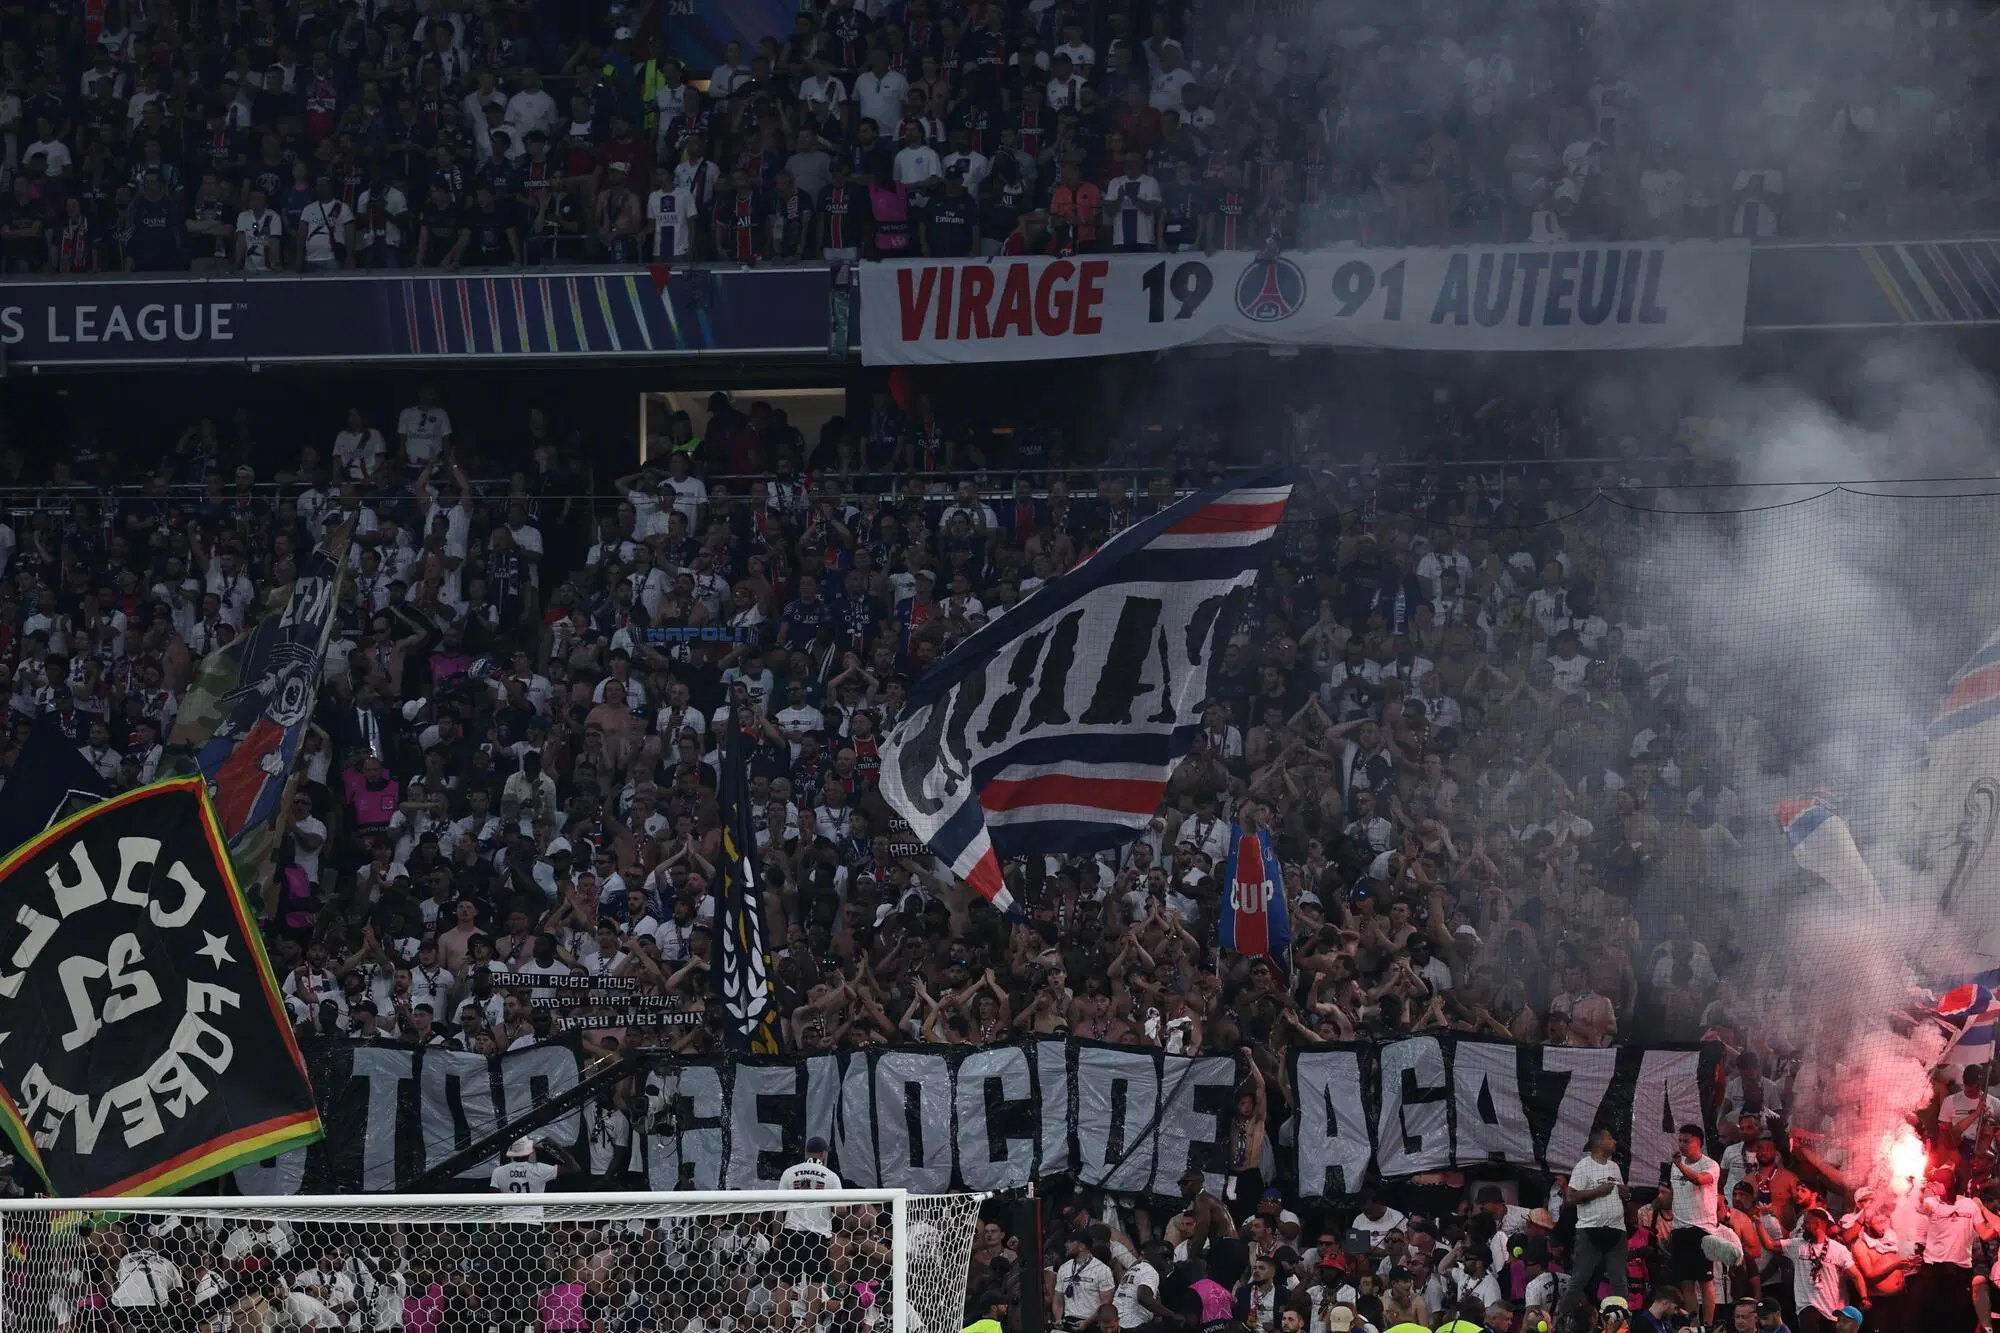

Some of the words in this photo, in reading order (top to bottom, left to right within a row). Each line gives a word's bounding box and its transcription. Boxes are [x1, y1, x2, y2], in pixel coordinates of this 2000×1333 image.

[668, 1, 695, 15] 241
[896, 261, 1109, 341] VIRAGE
[1142, 260, 1214, 324] 19
[1331, 260, 1407, 321] 91
[1430, 249, 1668, 328] AUTEUIL
[48, 303, 234, 342] LEAGUE
[647, 627, 744, 643] NAPOLI
[1230, 878, 1274, 914] CUP
[549, 975, 590, 988] AVEC
[615, 1013, 658, 1026] AVEC
[1296, 1051, 1372, 1197] A
[1376, 1036, 1707, 1189] GAZA
